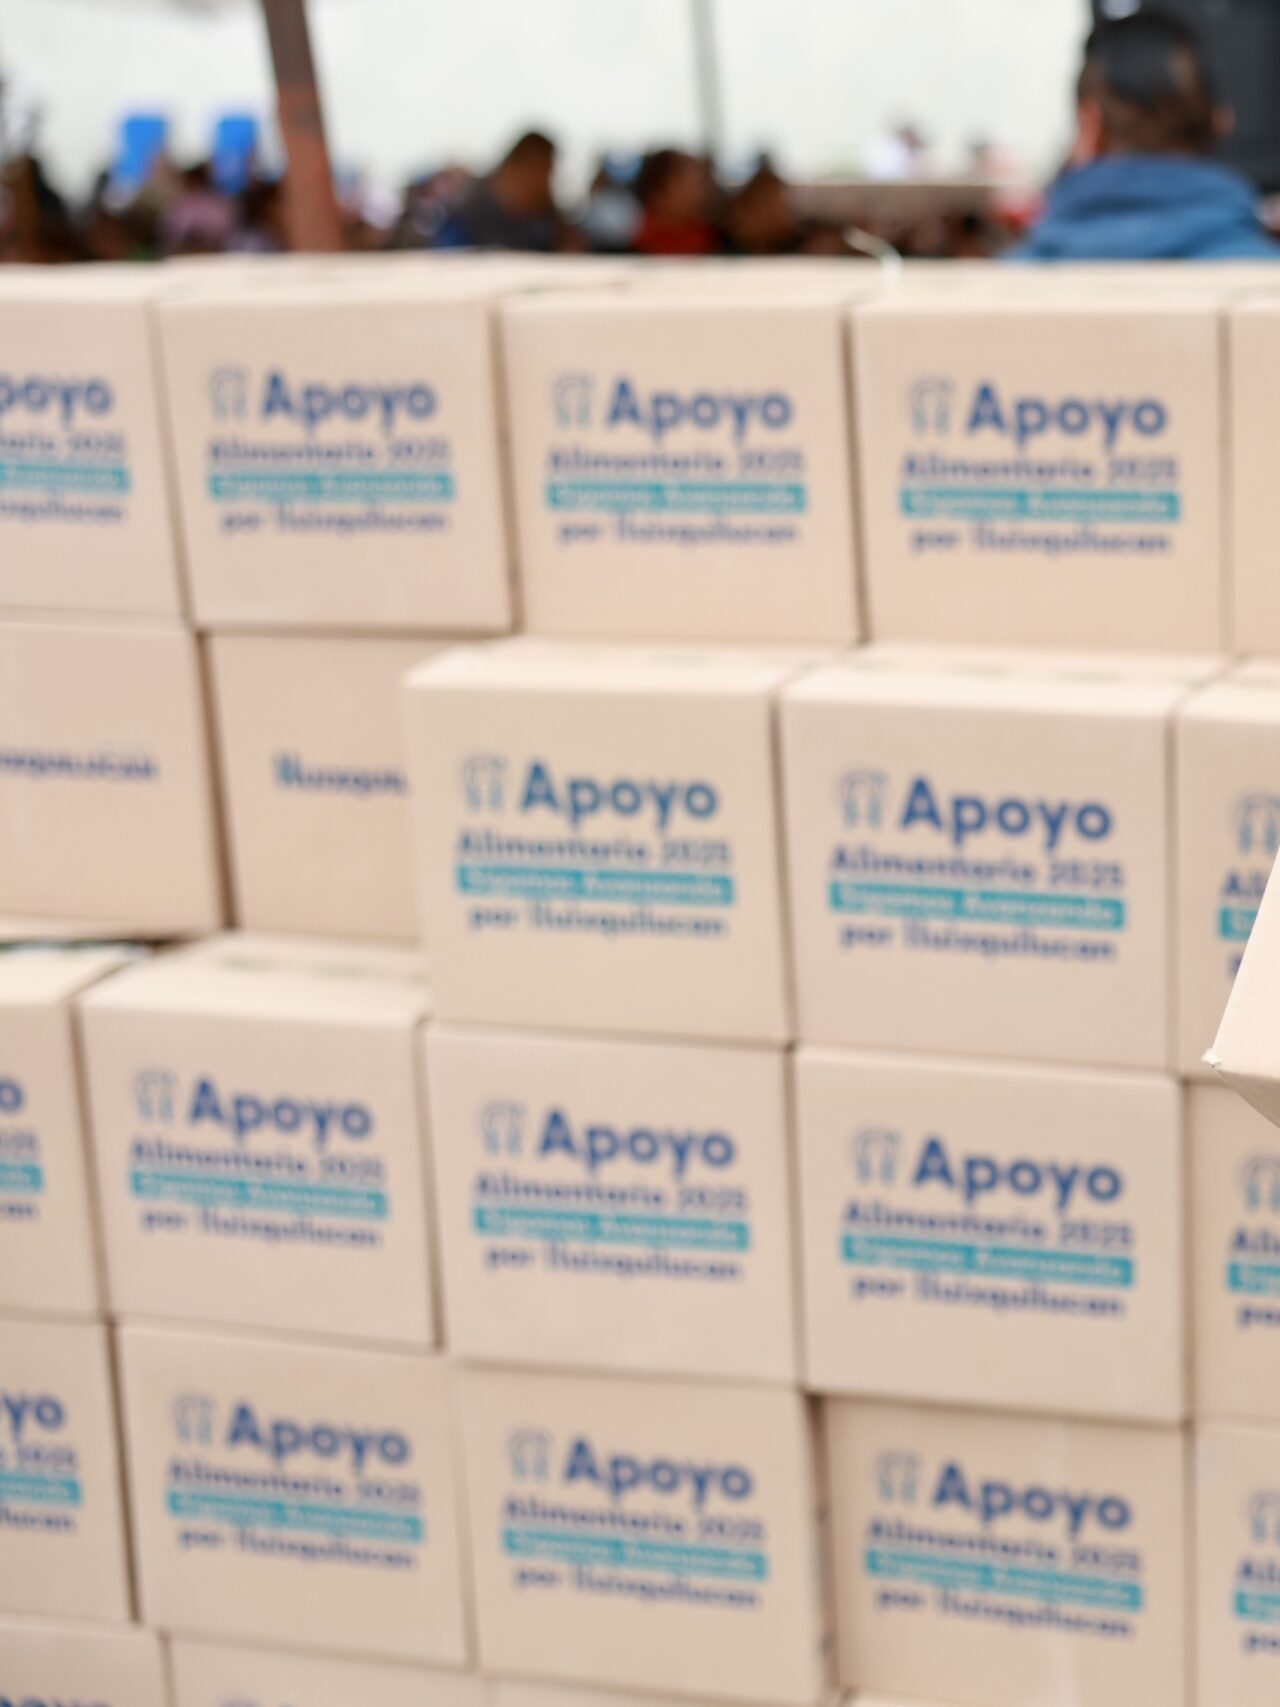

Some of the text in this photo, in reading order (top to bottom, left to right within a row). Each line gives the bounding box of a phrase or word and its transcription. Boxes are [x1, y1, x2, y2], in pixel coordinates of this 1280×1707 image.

[0, 372, 113, 432] poyo
[259, 369, 436, 435] Apoyo
[605, 376, 792, 444] Apoyo
[964, 381, 1167, 451] Apoyo
[518, 760, 719, 833] Apoyo
[897, 775, 1113, 854] Apoyo
[187, 1076, 372, 1150] Apoyo
[535, 1107, 735, 1181] Apoyo
[910, 1136, 1123, 1214] Apoyo
[225, 1401, 410, 1475] Apoyo
[561, 1436, 753, 1511] Apoyo
[931, 1461, 1130, 1540] Apoyo
